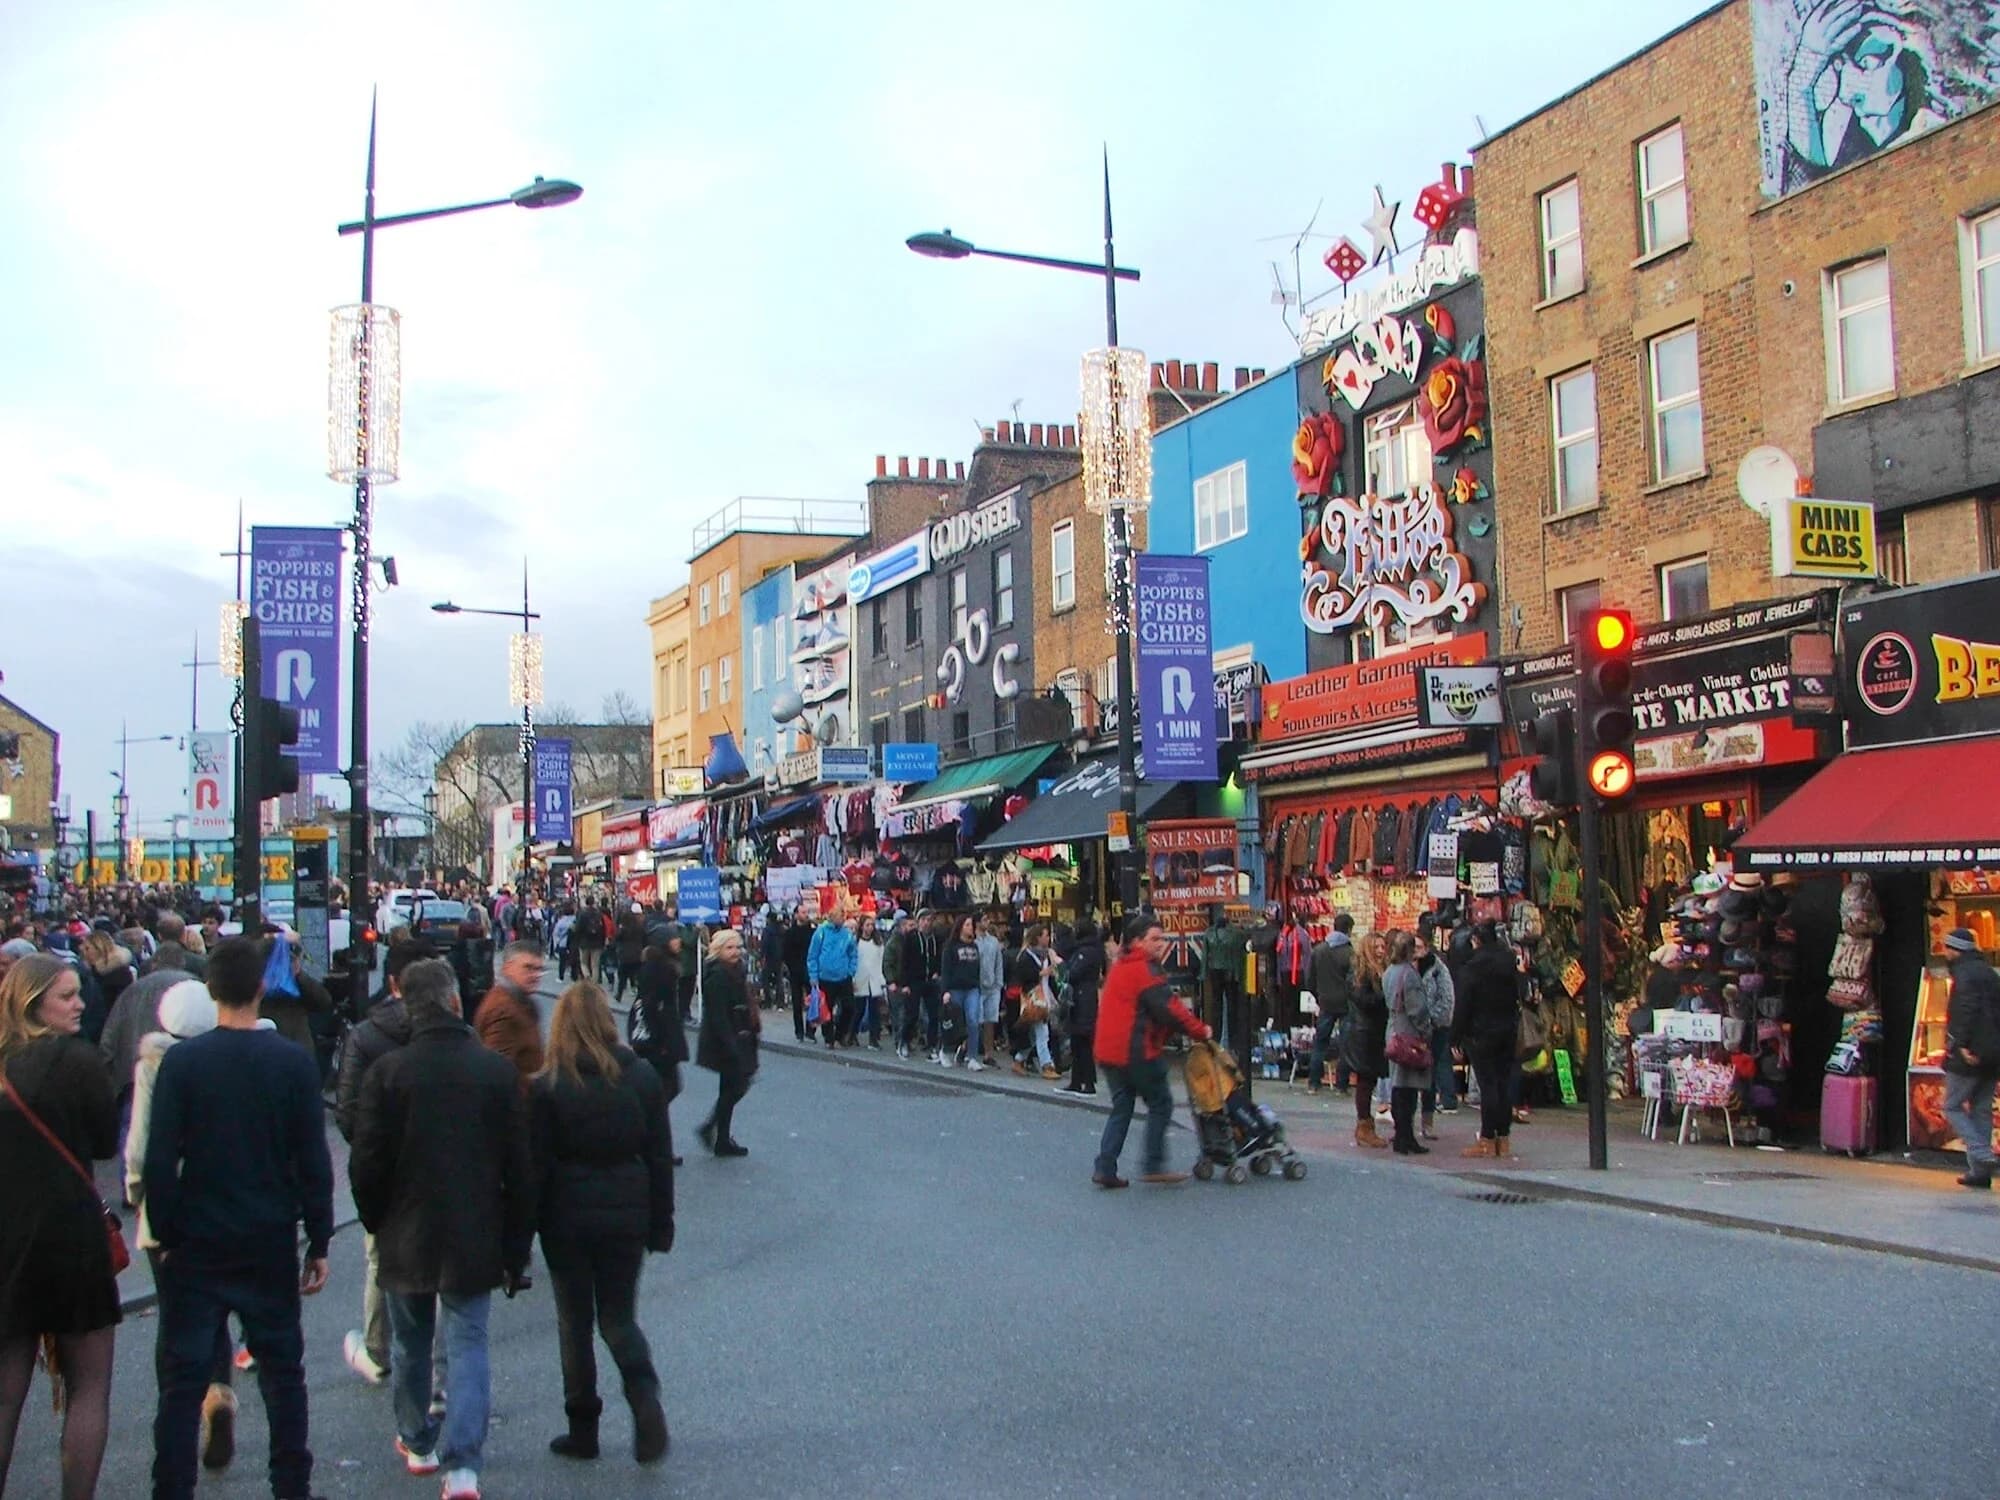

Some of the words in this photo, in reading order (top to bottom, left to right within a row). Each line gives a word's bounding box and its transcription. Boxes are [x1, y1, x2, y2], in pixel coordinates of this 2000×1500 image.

[1801, 506, 1859, 532] MINI
[1801, 533, 1863, 559] CABS
[256, 560, 334, 577] POPPIE'S
[256, 576, 318, 600] FISH
[322, 585, 334, 598] &
[1141, 585, 1205, 600] POPPIE'S
[256, 600, 334, 624] CHIPS
[1141, 601, 1193, 621] FISH
[1195, 607, 1206, 620] &
[1141, 622, 1207, 643] CHIPS
[1523, 656, 1556, 674] SMOKING
[1647, 632, 1671, 647] HATS
[1674, 619, 1732, 643] SUNGLASSES
[1736, 610, 1763, 630] BODY
[1287, 678, 1351, 702] Leather
[1356, 650, 1450, 686] Garments
[1702, 671, 1743, 692] Vintage
[1431, 682, 1498, 705] Martens
[1676, 680, 1791, 724] MARKET
[1155, 720, 1164, 738] 1
[1169, 720, 1201, 738] MIN
[1282, 711, 1348, 734] Souvenirs
[1349, 706, 1361, 720] &
[887, 761, 935, 771] EXCHANGE
[896, 751, 926, 761] MONEY
[193, 817, 200, 826] 2
[202, 818, 225, 826] min
[1151, 832, 1190, 848] SALE!
[1194, 829, 1233, 846] SALE!
[1750, 853, 1782, 864] DRINKS
[1795, 852, 1819, 864] PIZZA
[1832, 851, 1861, 863] FRESH
[1861, 851, 1885, 863] FAST
[1884, 850, 1910, 862] FOOD
[682, 879, 715, 887] MONEY
[1152, 888, 1169, 899] KEY
[1170, 887, 1192, 898] RING
[1193, 886, 1216, 897] FROM
[1215, 875, 1236, 896] £1
